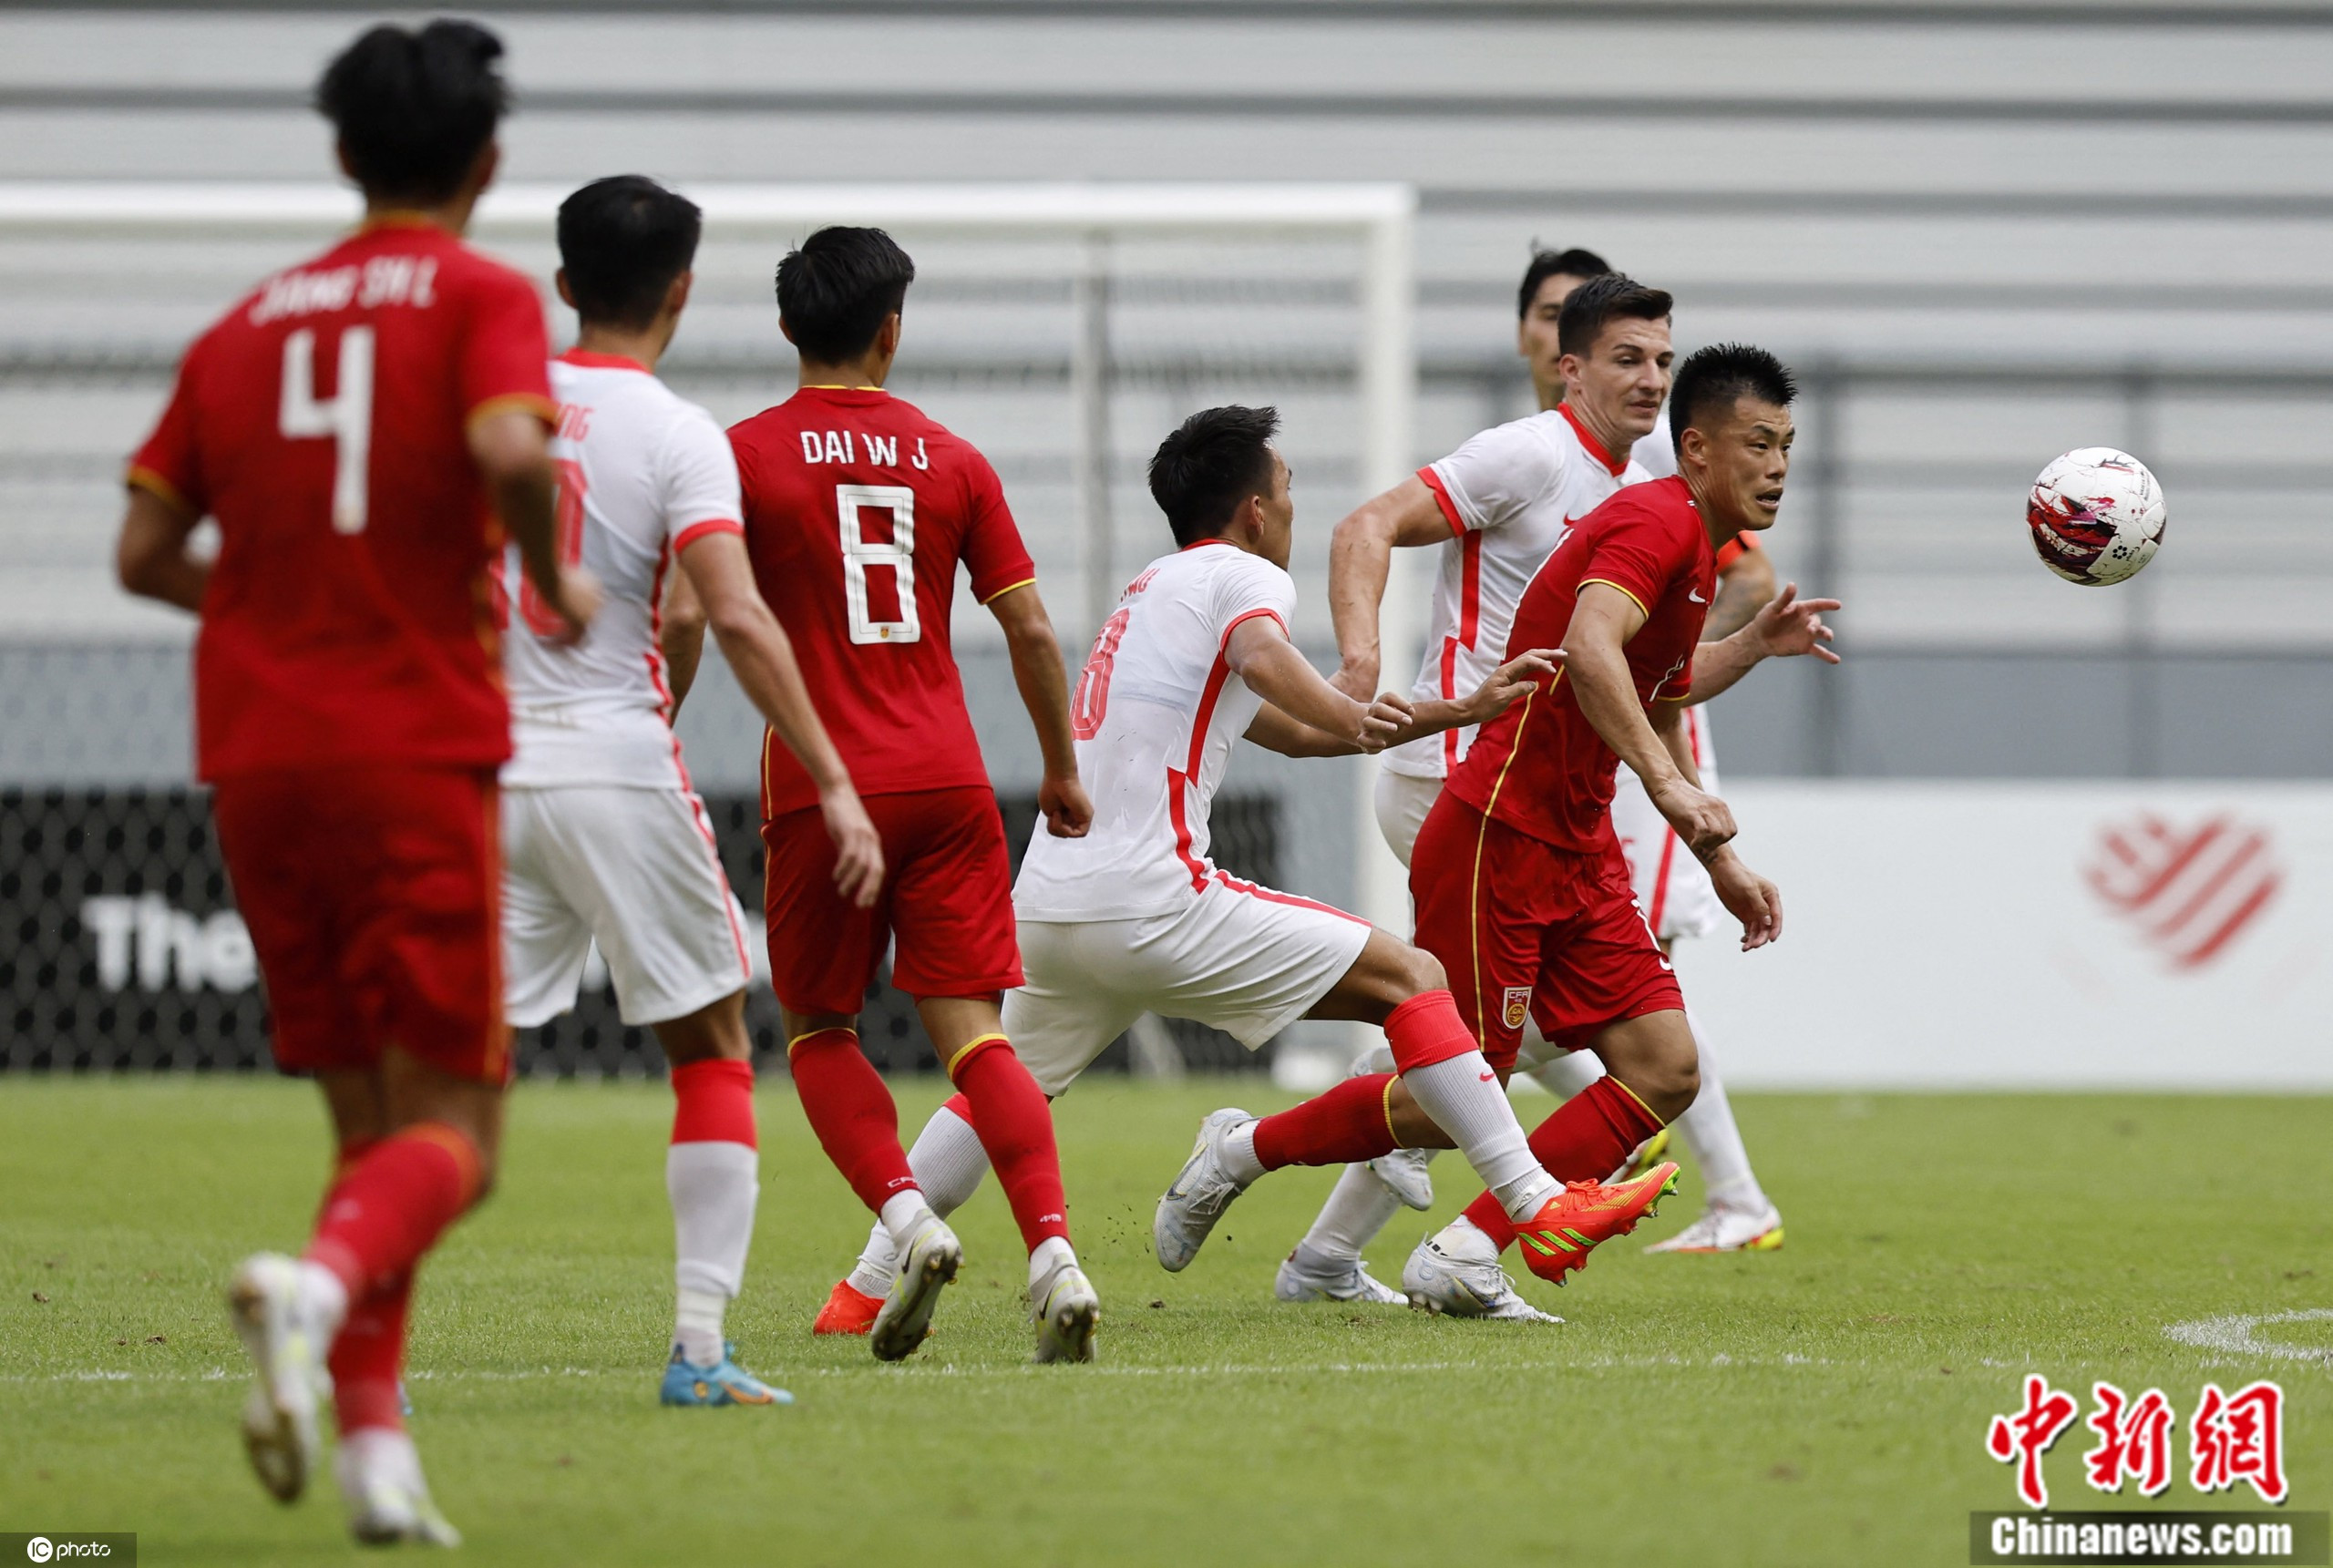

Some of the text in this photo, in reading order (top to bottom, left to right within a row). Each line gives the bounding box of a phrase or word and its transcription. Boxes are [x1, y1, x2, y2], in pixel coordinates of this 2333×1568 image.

[280, 324, 375, 533] 4
[800, 430, 929, 470] DAI W J
[836, 484, 921, 645] 8
[1069, 607, 1130, 741] 8
[80, 893, 259, 994] The
